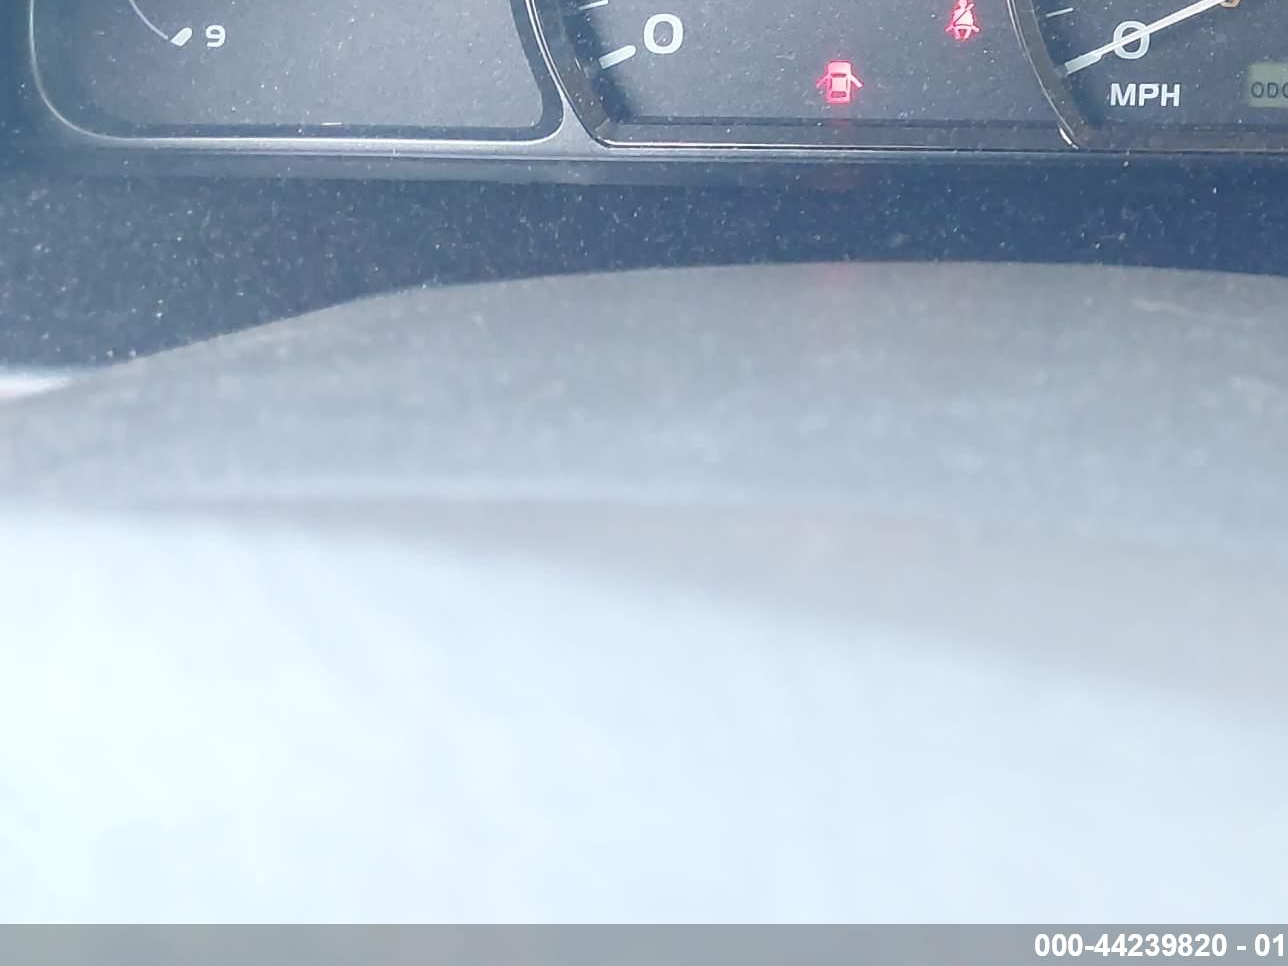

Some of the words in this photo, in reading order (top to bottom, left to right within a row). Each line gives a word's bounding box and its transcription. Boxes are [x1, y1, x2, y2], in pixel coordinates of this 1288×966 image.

[205, 24, 226, 48] 9
[643, 13, 684, 55] 0
[1113, 21, 1150, 60] 0
[1110, 82, 1181, 107] MPH
